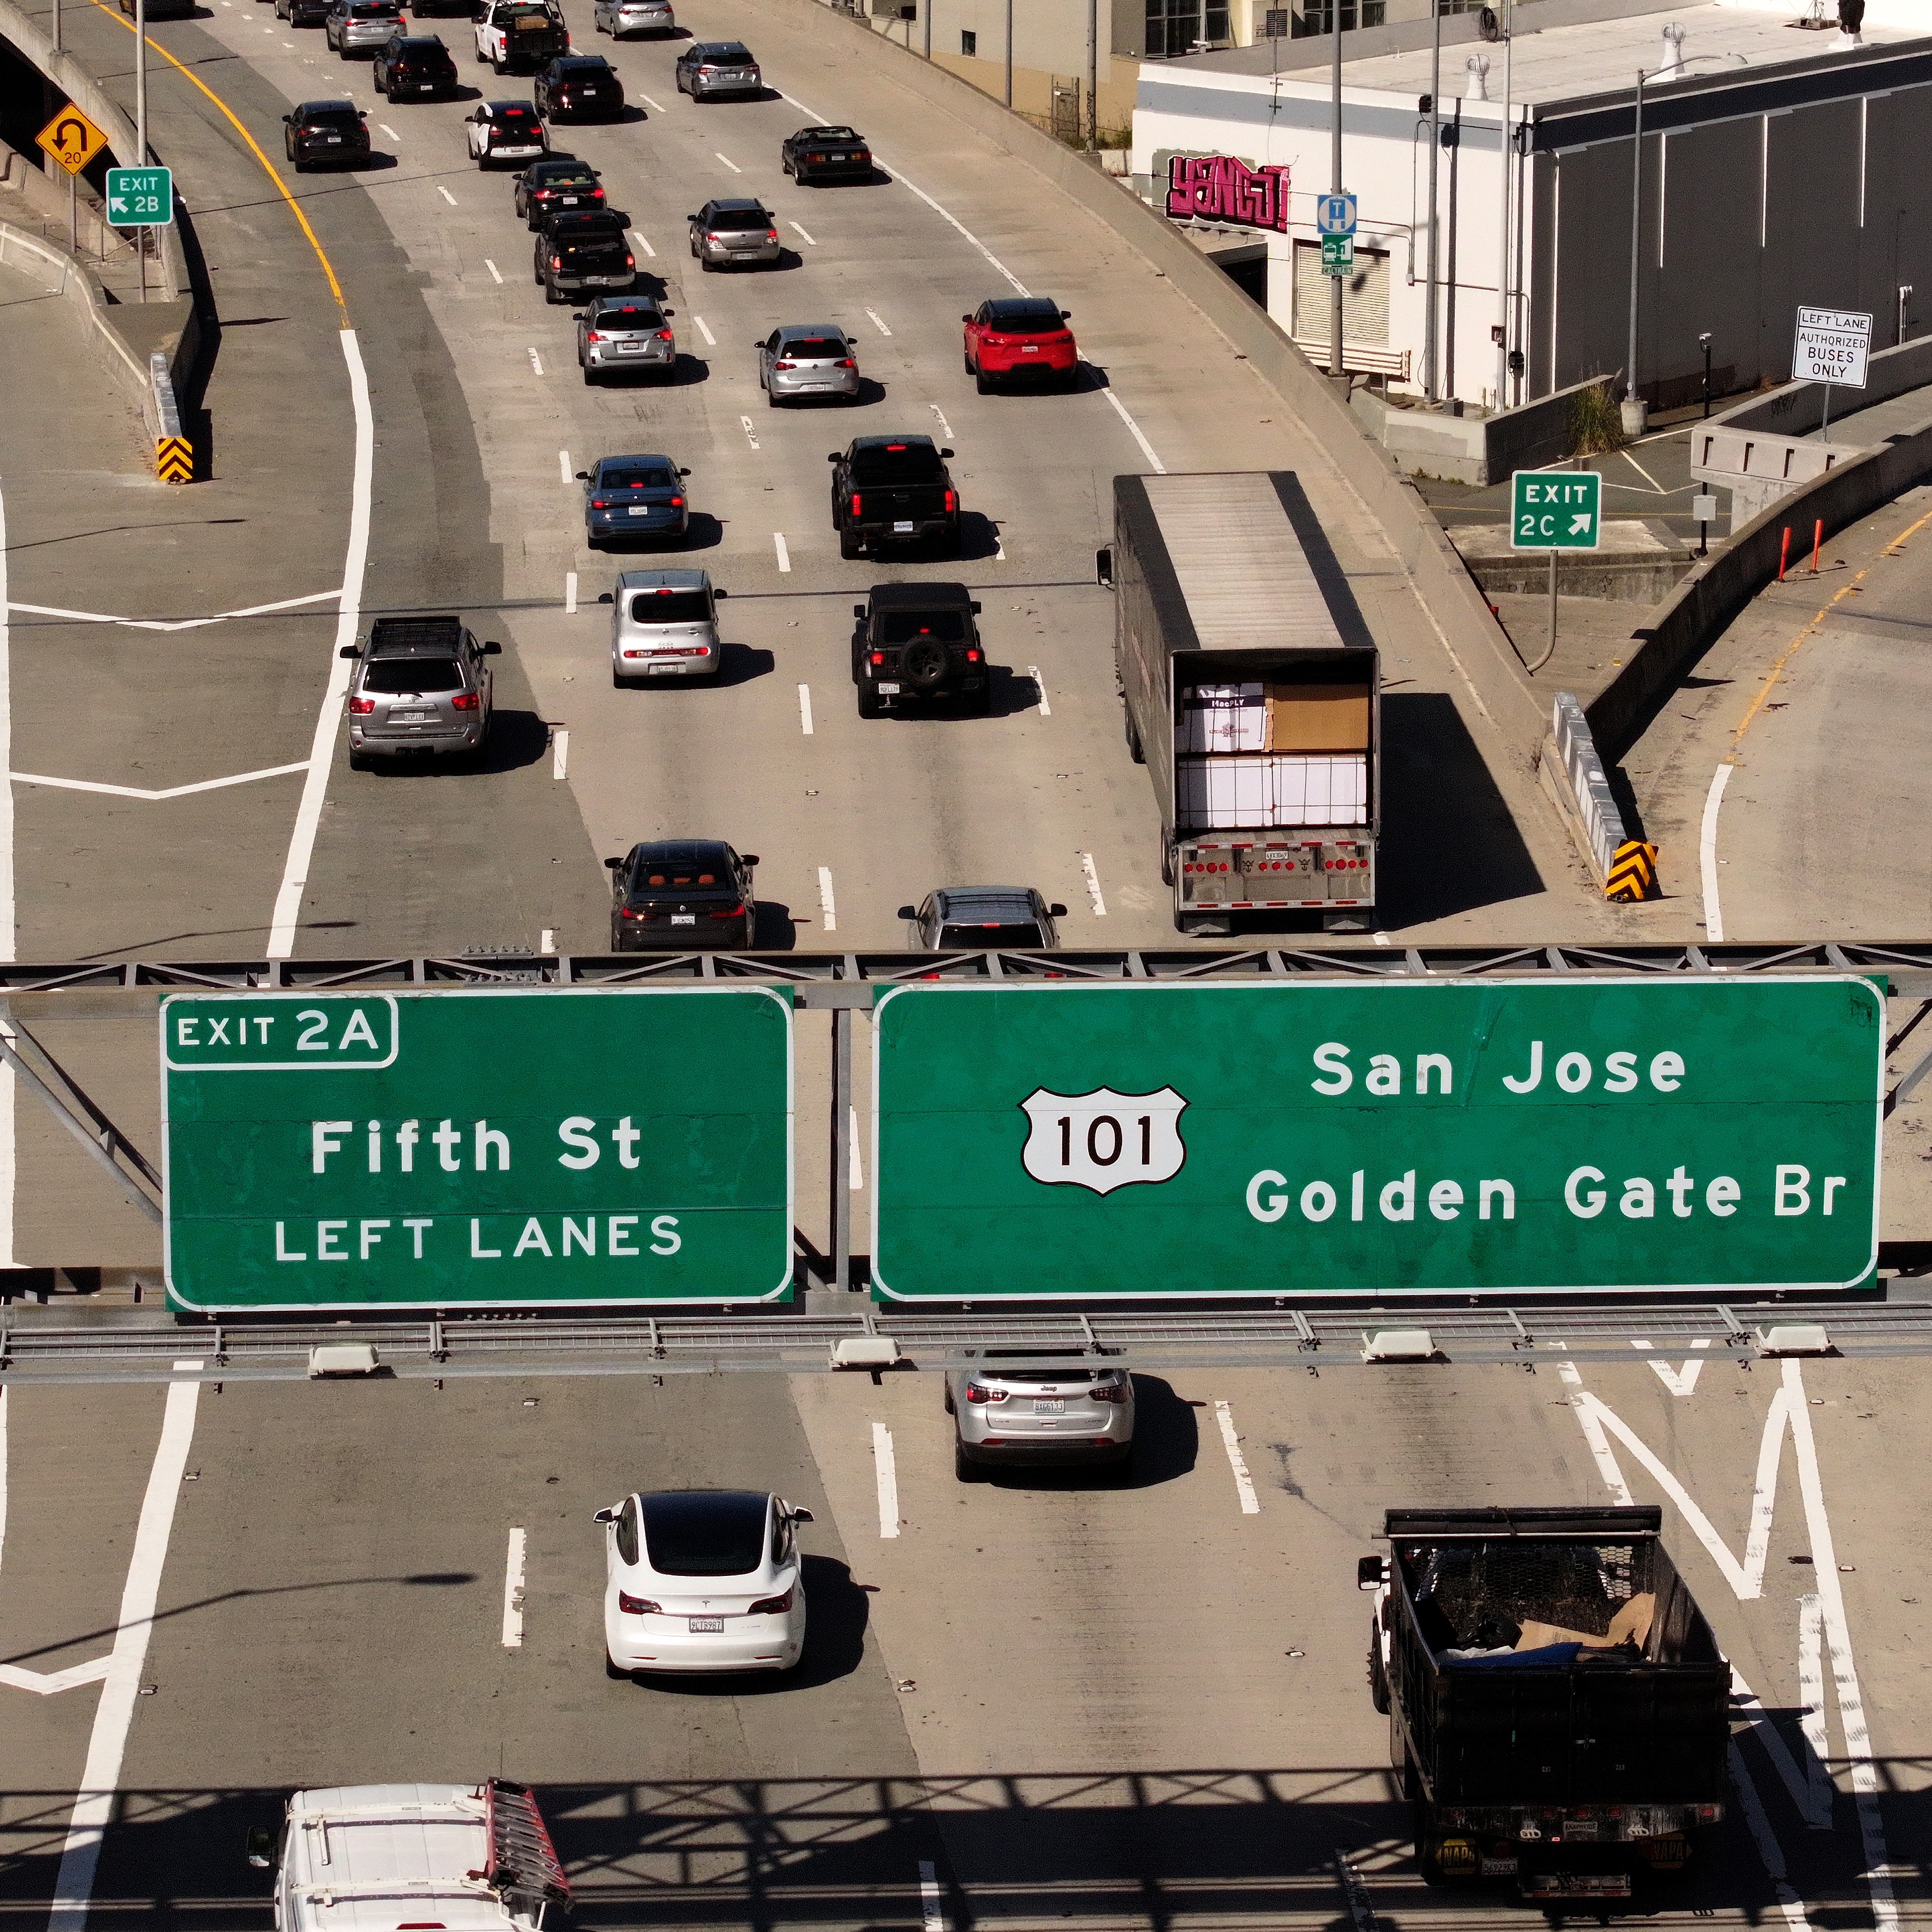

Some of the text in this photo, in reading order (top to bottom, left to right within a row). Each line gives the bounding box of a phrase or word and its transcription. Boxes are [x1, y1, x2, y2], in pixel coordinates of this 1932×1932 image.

[64, 152, 82, 164] 20
[120, 177, 158, 191] EXIT
[135, 196, 159, 212] 2B
[1802, 313, 1867, 329] LEFT LANE
[1799, 332, 1866, 348] AUTHORIZED
[1808, 346, 1854, 363] BUSES
[1812, 363, 1847, 378] ONLY
[1526, 485, 1588, 503] EXIT
[1520, 515, 1555, 536] 2C
[178, 1008, 379, 1051] EXIT 2A
[1310, 1040, 1686, 1096] San Jose
[312, 1115, 641, 1174] Fifth St
[1057, 1114, 1151, 1167] 101
[1245, 1164, 1847, 1223] Golden Gate Br
[275, 1214, 682, 1261] LEFT LANES
[1443, 1847, 1475, 1867] NAPA
